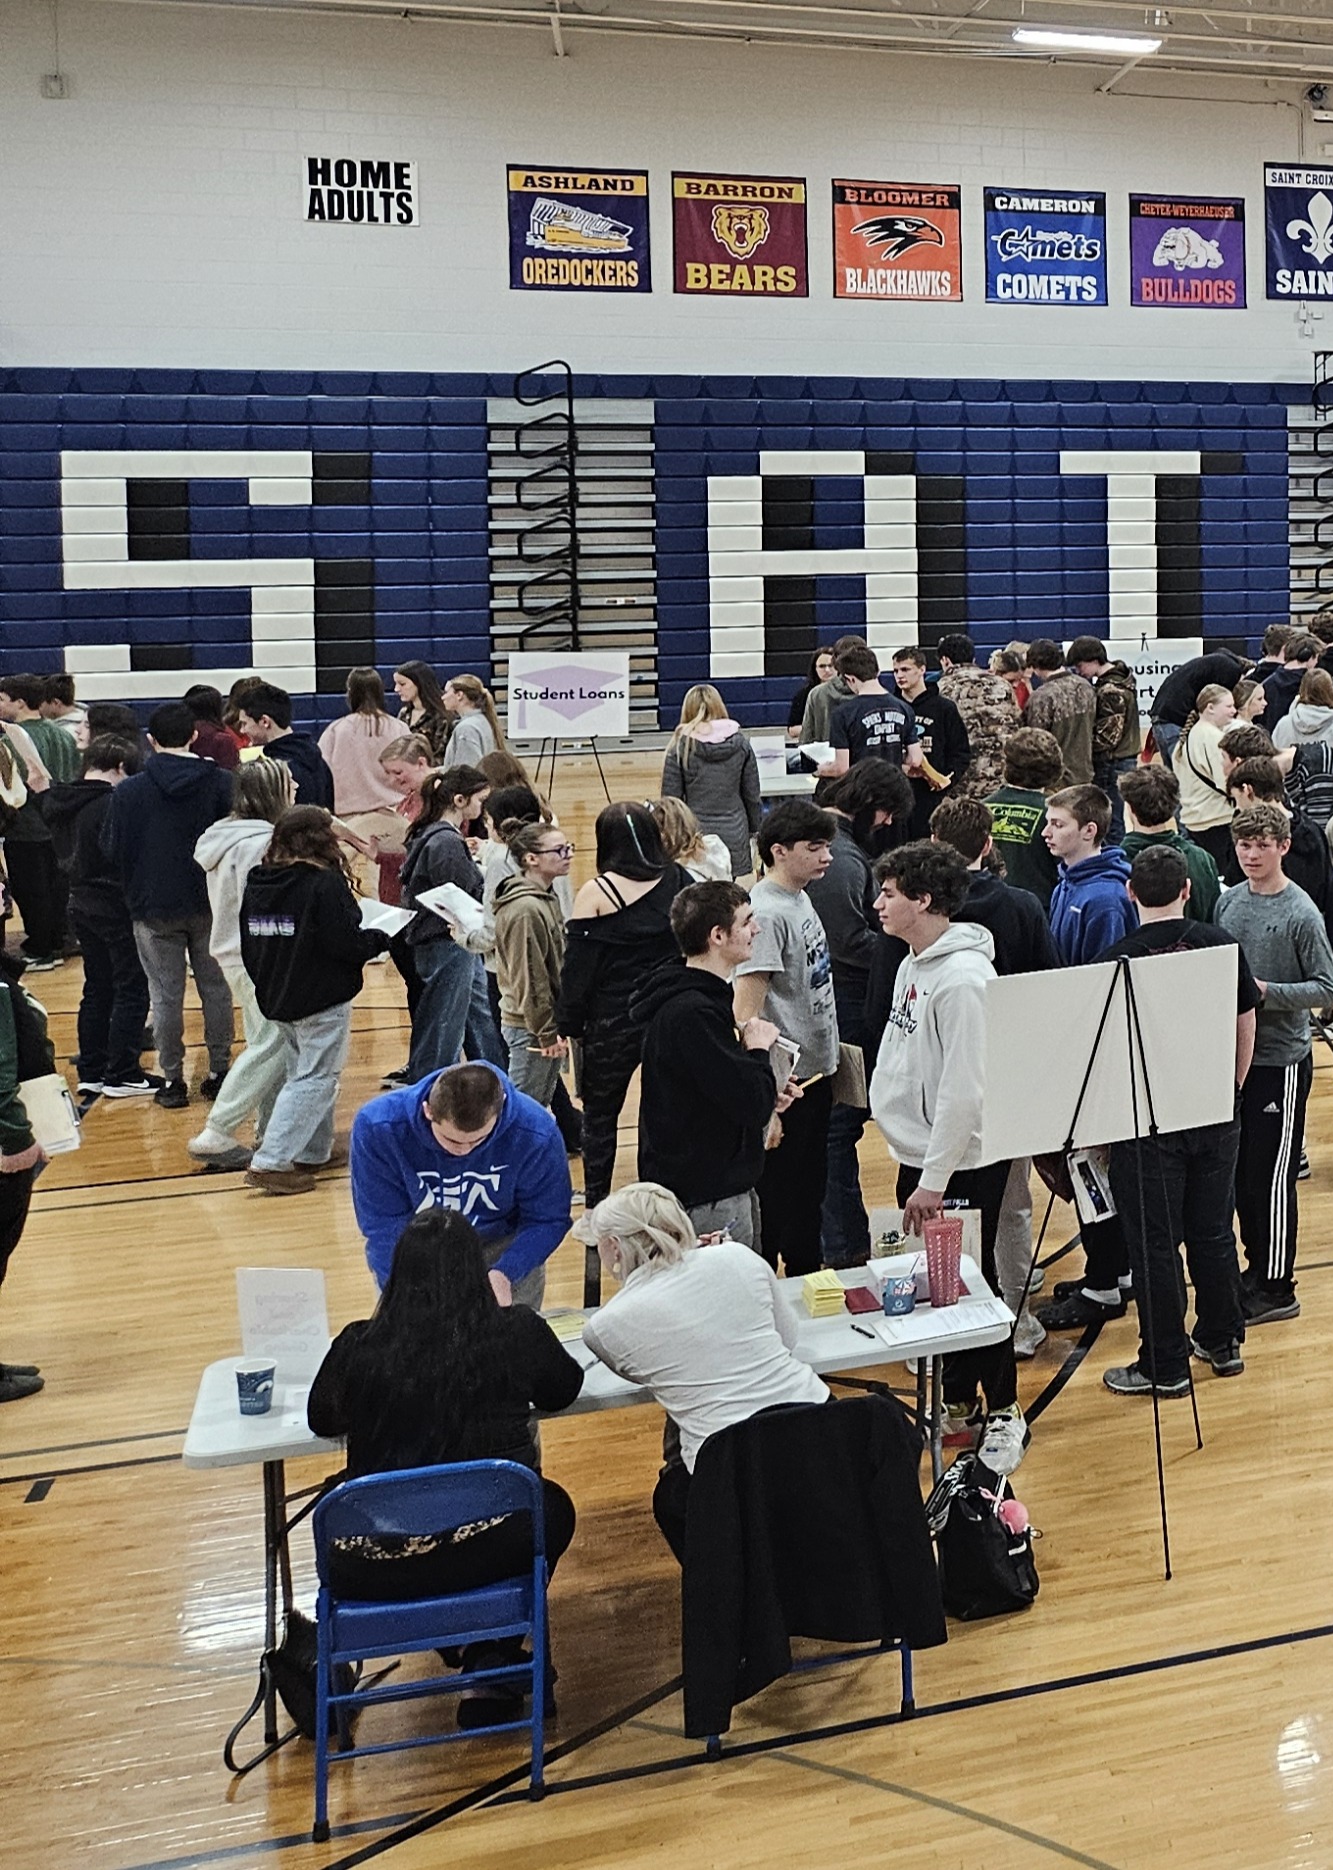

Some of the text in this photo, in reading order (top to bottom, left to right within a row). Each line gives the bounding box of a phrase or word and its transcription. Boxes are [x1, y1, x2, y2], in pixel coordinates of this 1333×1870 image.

[308, 157, 411, 190] HOME
[522, 175, 634, 191] ASHLAND
[1271, 172, 1301, 184] SAINT
[1305, 174, 1333, 186] CROIX
[685, 182, 794, 199] BARRON
[844, 189, 949, 206] BLOOMER
[308, 188, 413, 224] ADULTS
[995, 197, 1095, 214] CAMERON
[1140, 202, 1235, 218] CHETEK-WEYERHAEUSER
[522, 257, 639, 287] OREDOCKERS
[686, 262, 797, 292] BEARS
[845, 268, 951, 296] BLACKHAWKS
[996, 273, 1097, 301] COMETS
[1141, 278, 1236, 304] BULLDOGS
[513, 687, 625, 700] Student Loans
